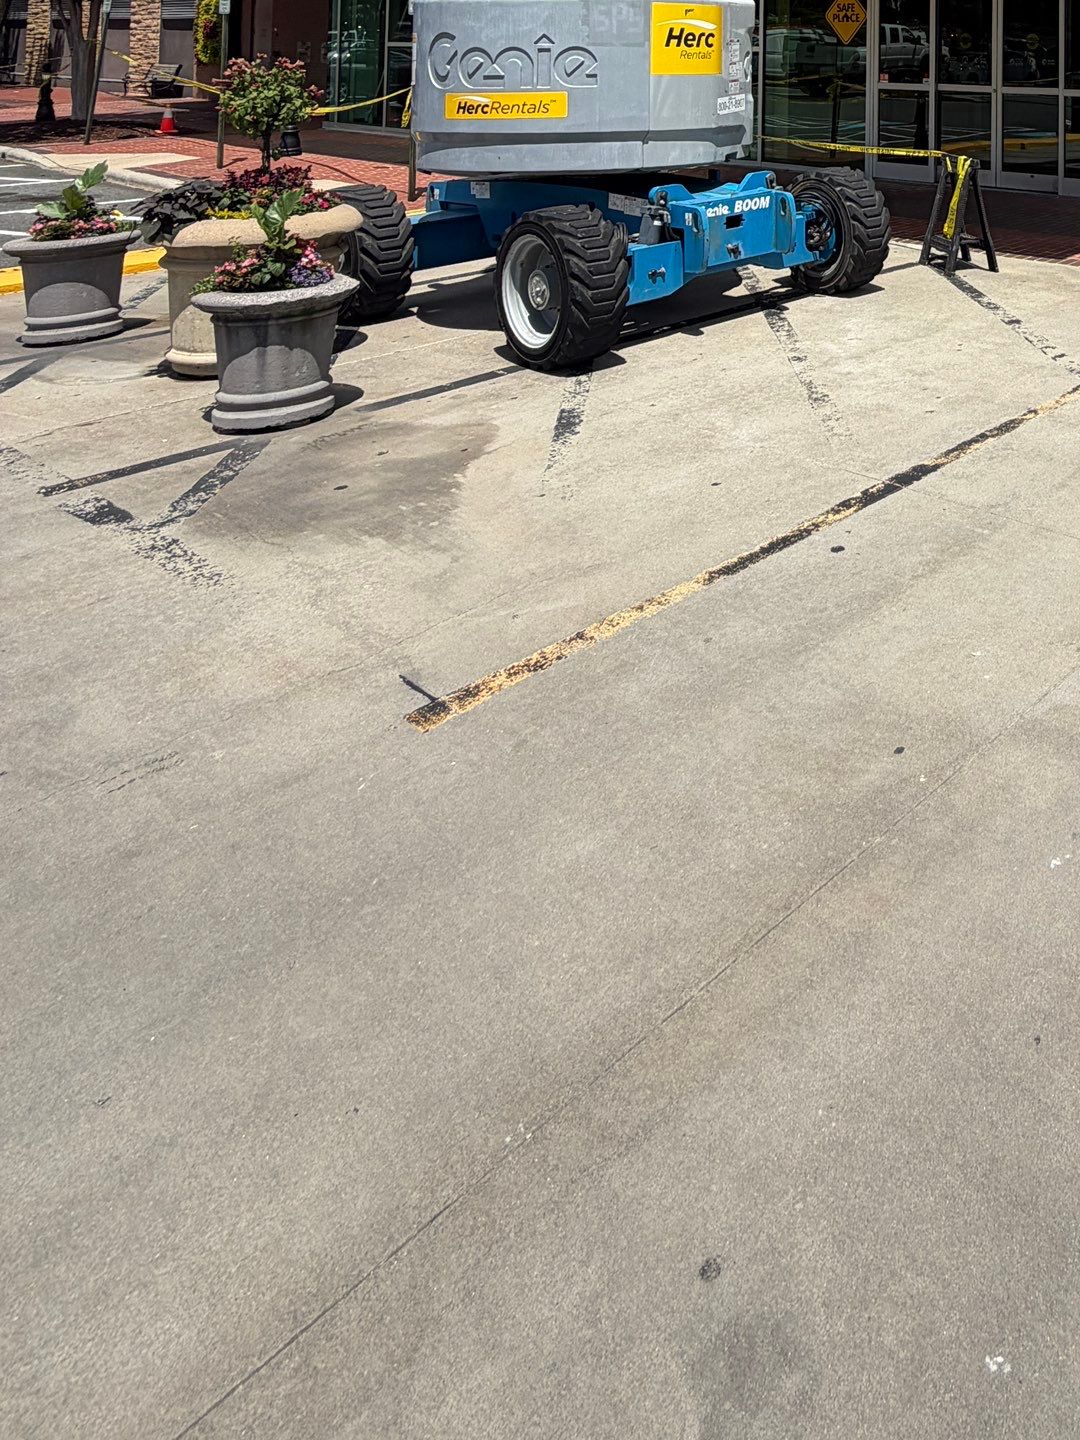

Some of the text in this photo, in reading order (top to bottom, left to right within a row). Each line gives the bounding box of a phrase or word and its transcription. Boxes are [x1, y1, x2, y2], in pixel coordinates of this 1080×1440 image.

[836, 3, 856, 12] SAFE
[832, 13, 860, 22] PLACE
[665, 27, 716, 48] Herc
[428, 31, 598, 89] Genie
[679, 49, 713, 60] Rentals
[706, 196, 771, 217] enie BOOM
